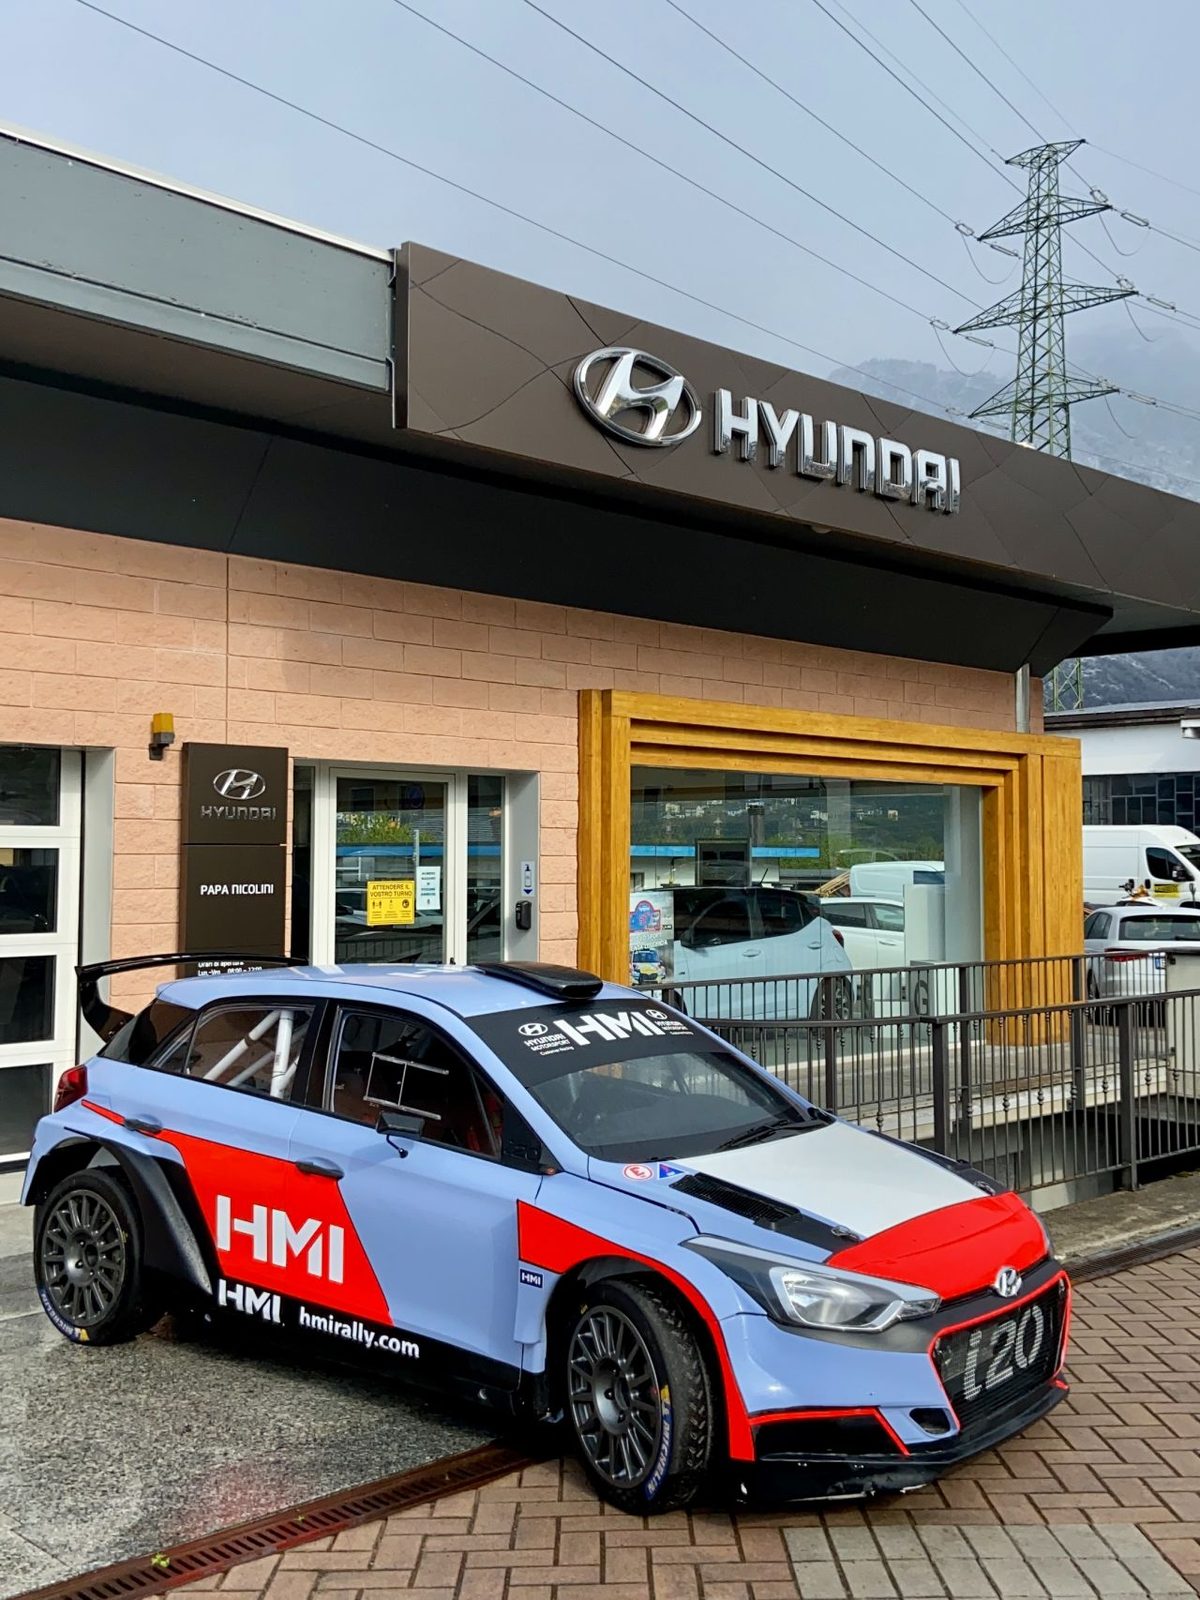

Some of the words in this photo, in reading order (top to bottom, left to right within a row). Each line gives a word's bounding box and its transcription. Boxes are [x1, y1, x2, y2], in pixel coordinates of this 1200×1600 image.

[713, 388, 960, 514] HYUNDAI
[201, 805, 276, 821] HYUNDAI
[200, 884, 230, 896] PAPA
[231, 883, 275, 896] NICOLINI
[523, 1033, 567, 1047] HYUNDAI
[553, 1011, 666, 1046] HMI
[530, 1039, 571, 1051] MOTORSPORT
[216, 1194, 344, 1284] HMI
[521, 1272, 541, 1286] HMI
[218, 1278, 281, 1324] HMI
[299, 1306, 420, 1359] hmirally.com
[647, 1421, 670, 1494] MICHELIN
